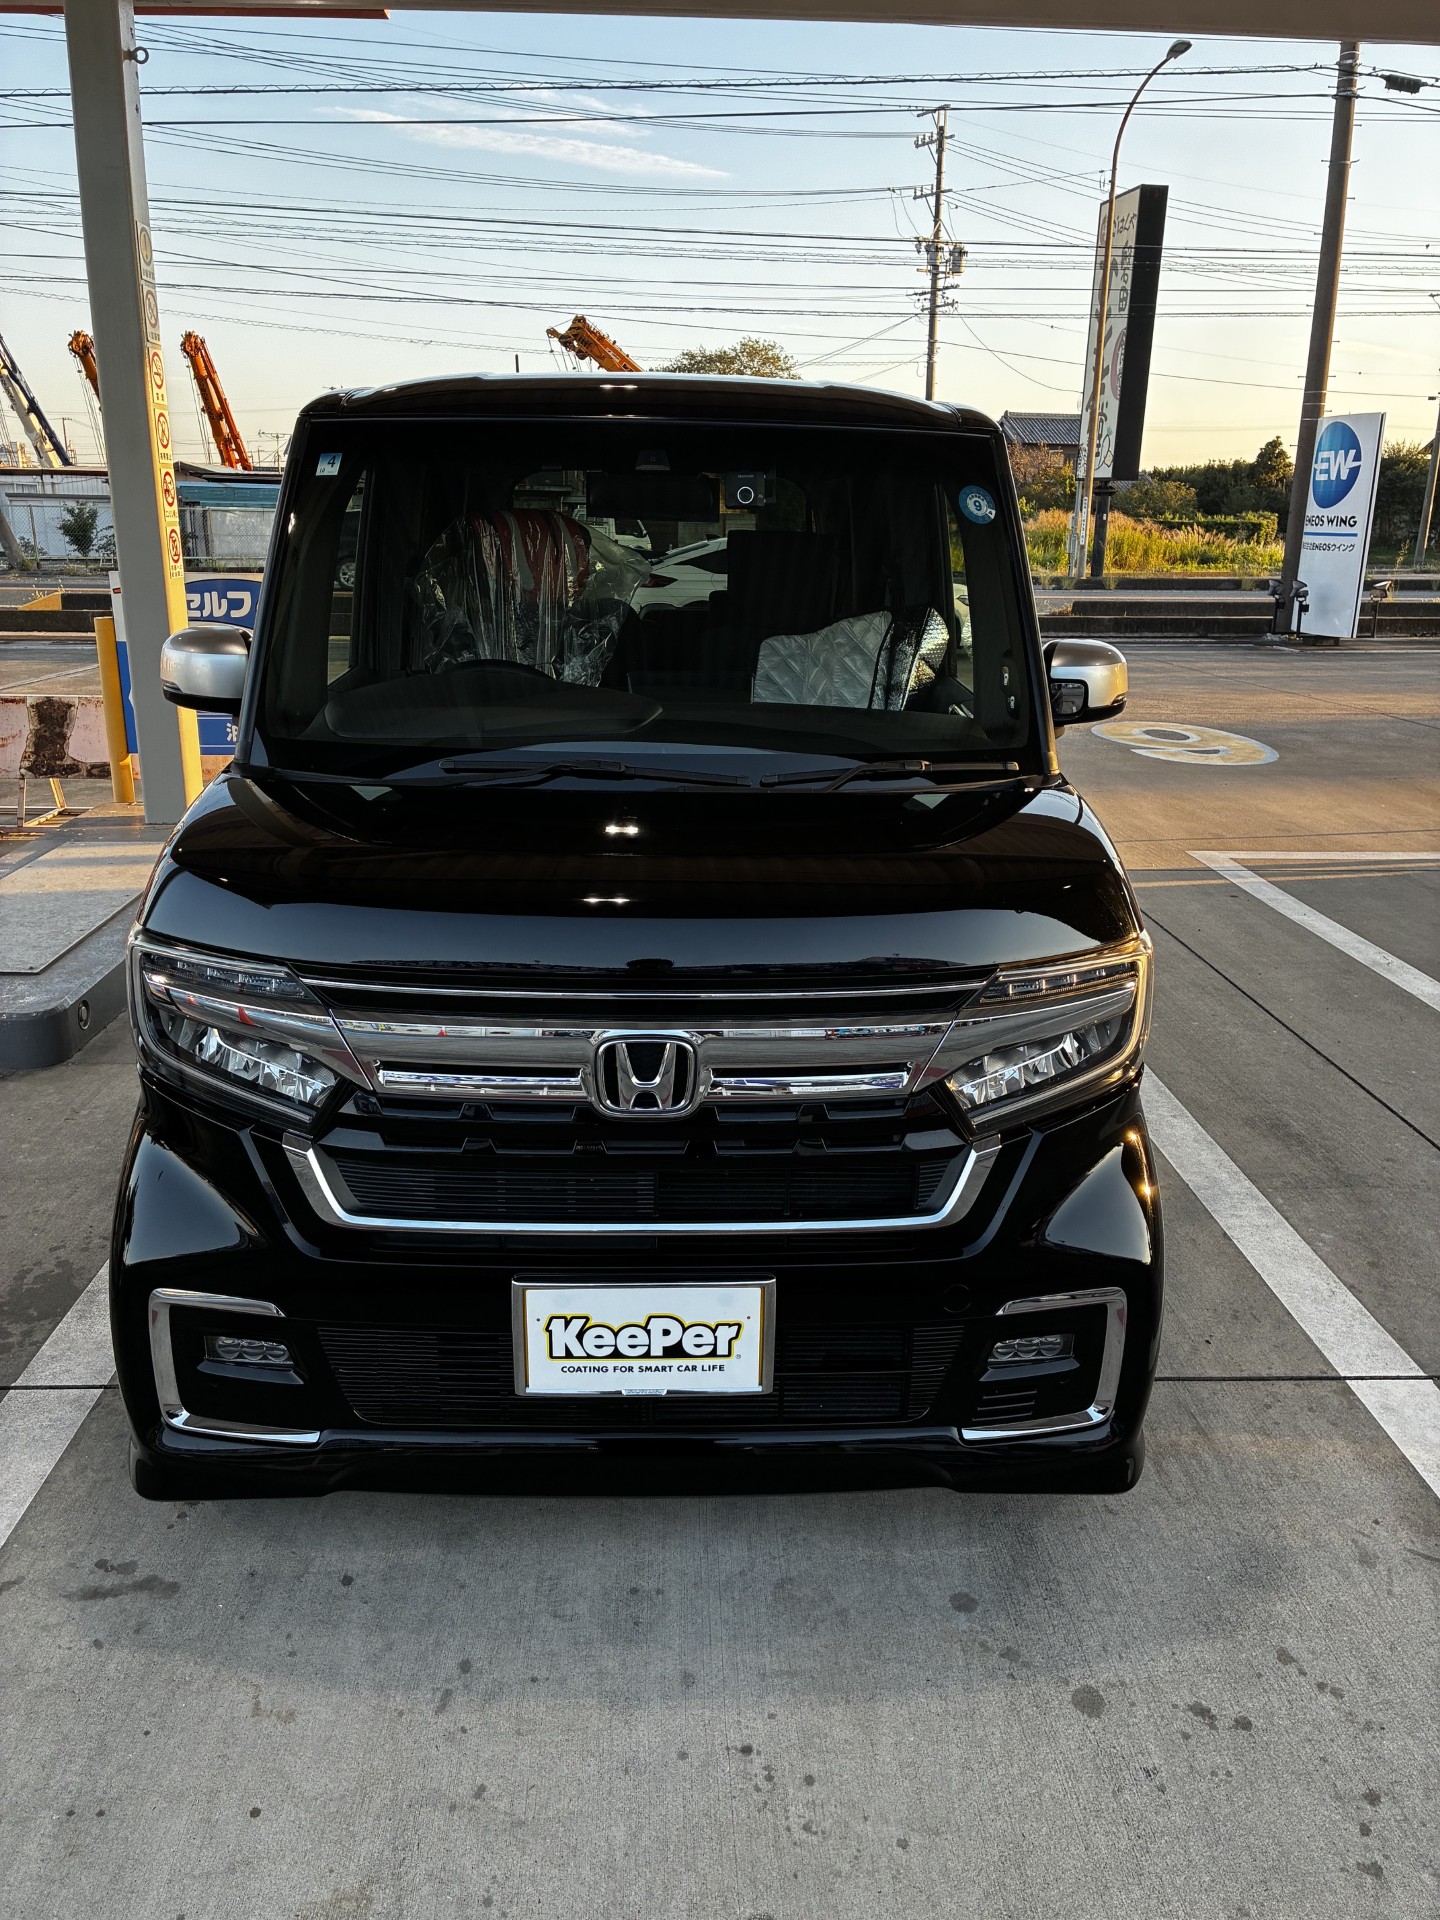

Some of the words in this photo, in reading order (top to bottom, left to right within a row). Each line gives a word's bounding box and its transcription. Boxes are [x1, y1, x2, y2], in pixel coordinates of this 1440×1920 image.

[974, 500, 982, 511] 9
[1327, 515, 1358, 528] WING
[546, 1315, 742, 1359] KeePer
[561, 1365, 609, 1374] COATING
[613, 1365, 634, 1373] FOR
[638, 1364, 673, 1373] SMART
[676, 1364, 698, 1372] CAR
[701, 1363, 725, 1372] LIFE
